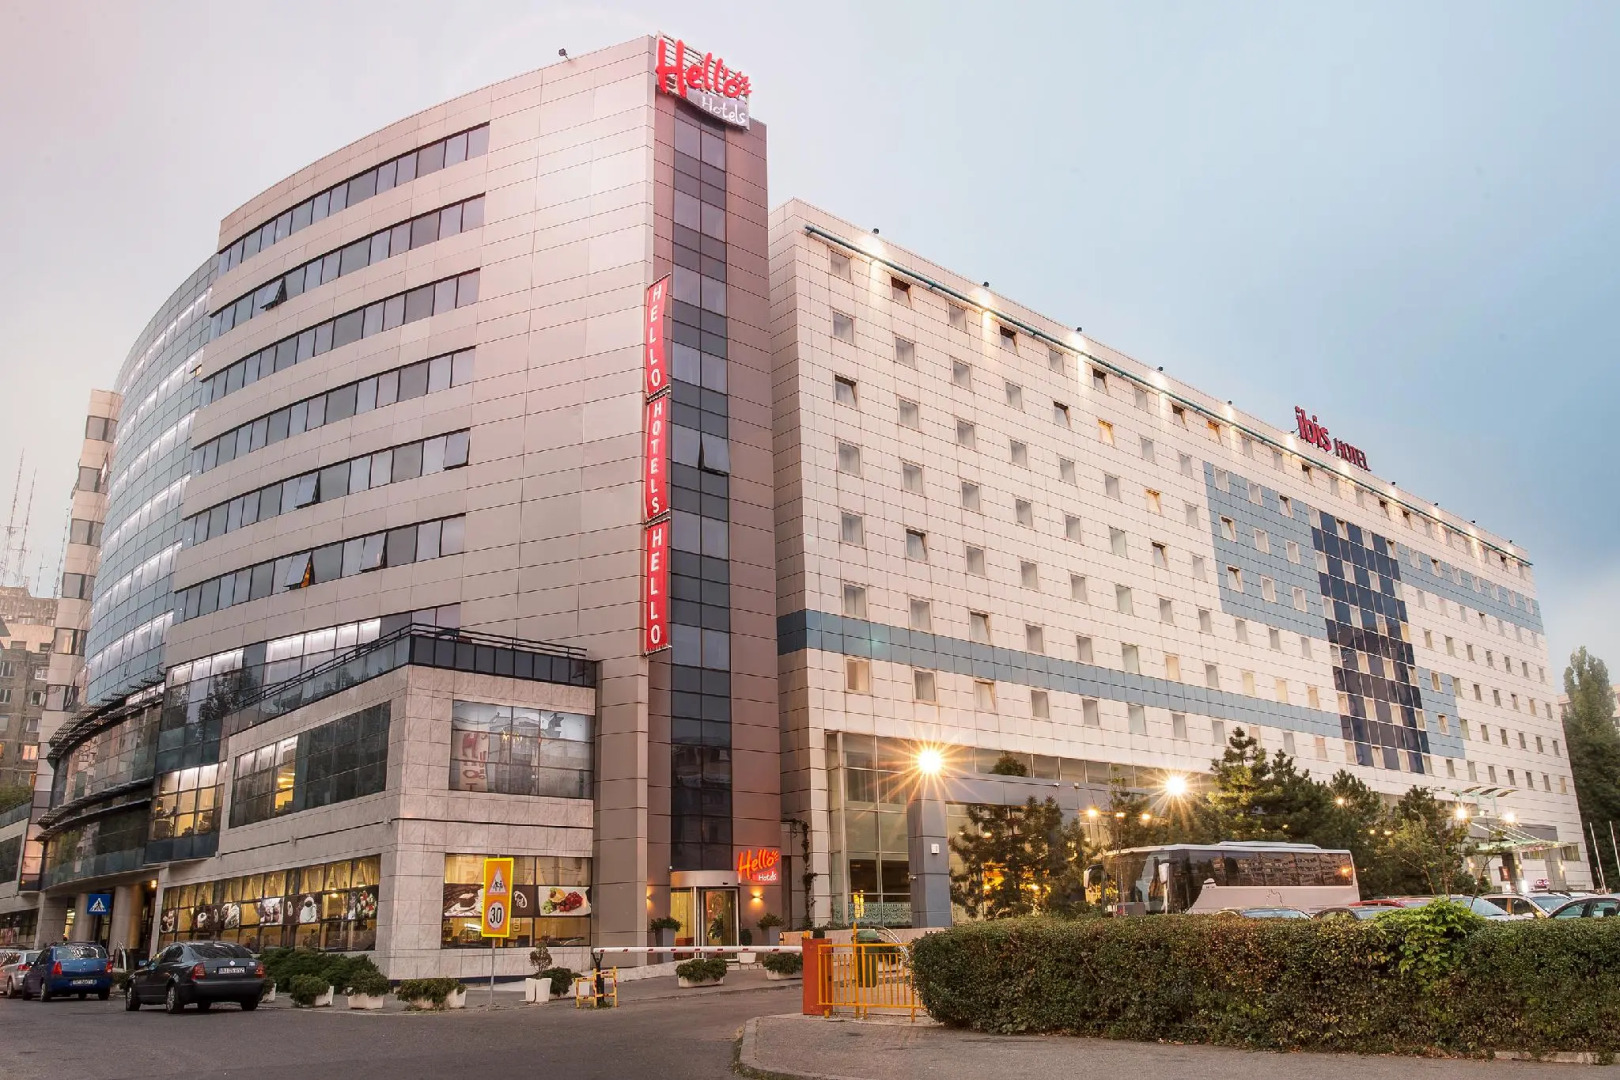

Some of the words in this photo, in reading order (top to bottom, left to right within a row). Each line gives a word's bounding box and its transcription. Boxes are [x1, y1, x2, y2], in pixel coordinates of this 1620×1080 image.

[656, 38, 743, 98] Hello
[701, 96, 746, 124] Hotels
[649, 283, 663, 387] HELLO
[650, 401, 663, 514] HOTELS
[1295, 405, 1332, 452] ibis
[1333, 437, 1370, 471] HOTEL
[650, 528, 662, 644] HELLO
[737, 849, 776, 884] Hello
[490, 907, 503, 924] 30
